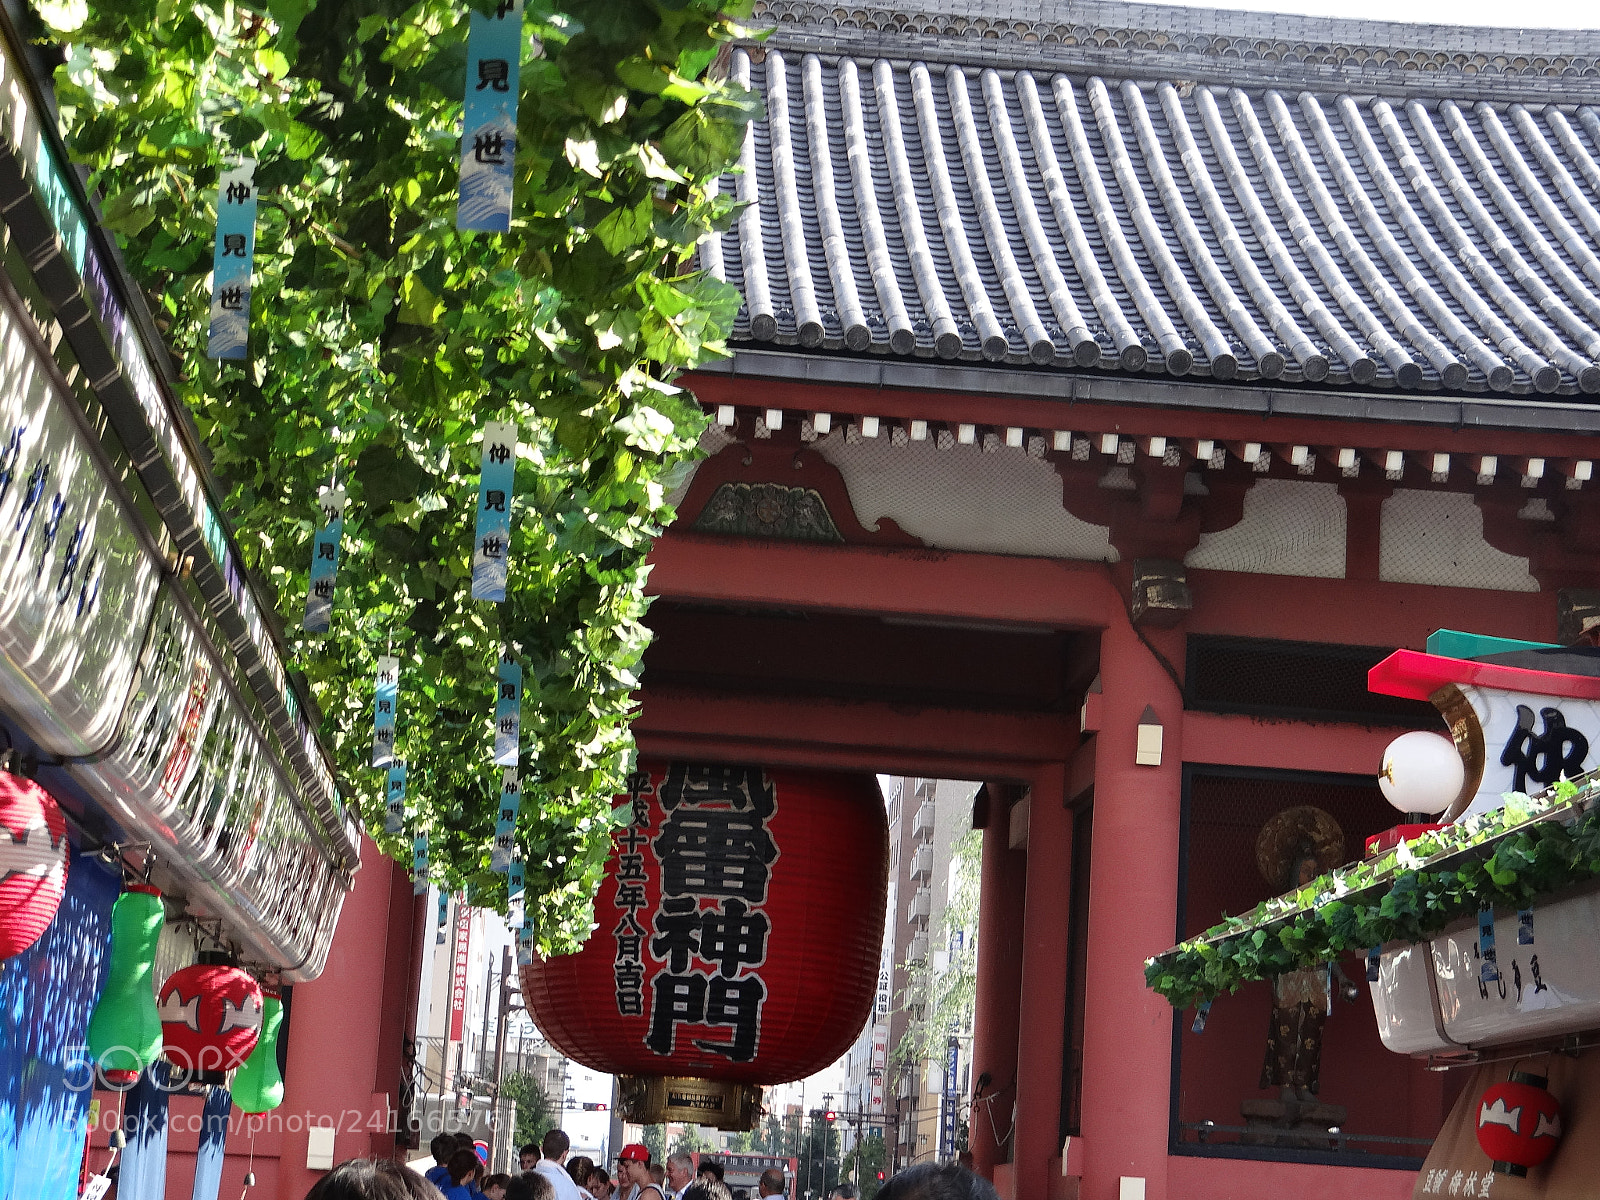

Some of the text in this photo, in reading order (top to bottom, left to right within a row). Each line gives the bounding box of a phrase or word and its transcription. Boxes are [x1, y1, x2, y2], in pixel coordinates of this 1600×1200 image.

[219, 181, 251, 310] 仲見世
[482, 443, 511, 558] 仲見世
[377, 670, 393, 744] 仲見世
